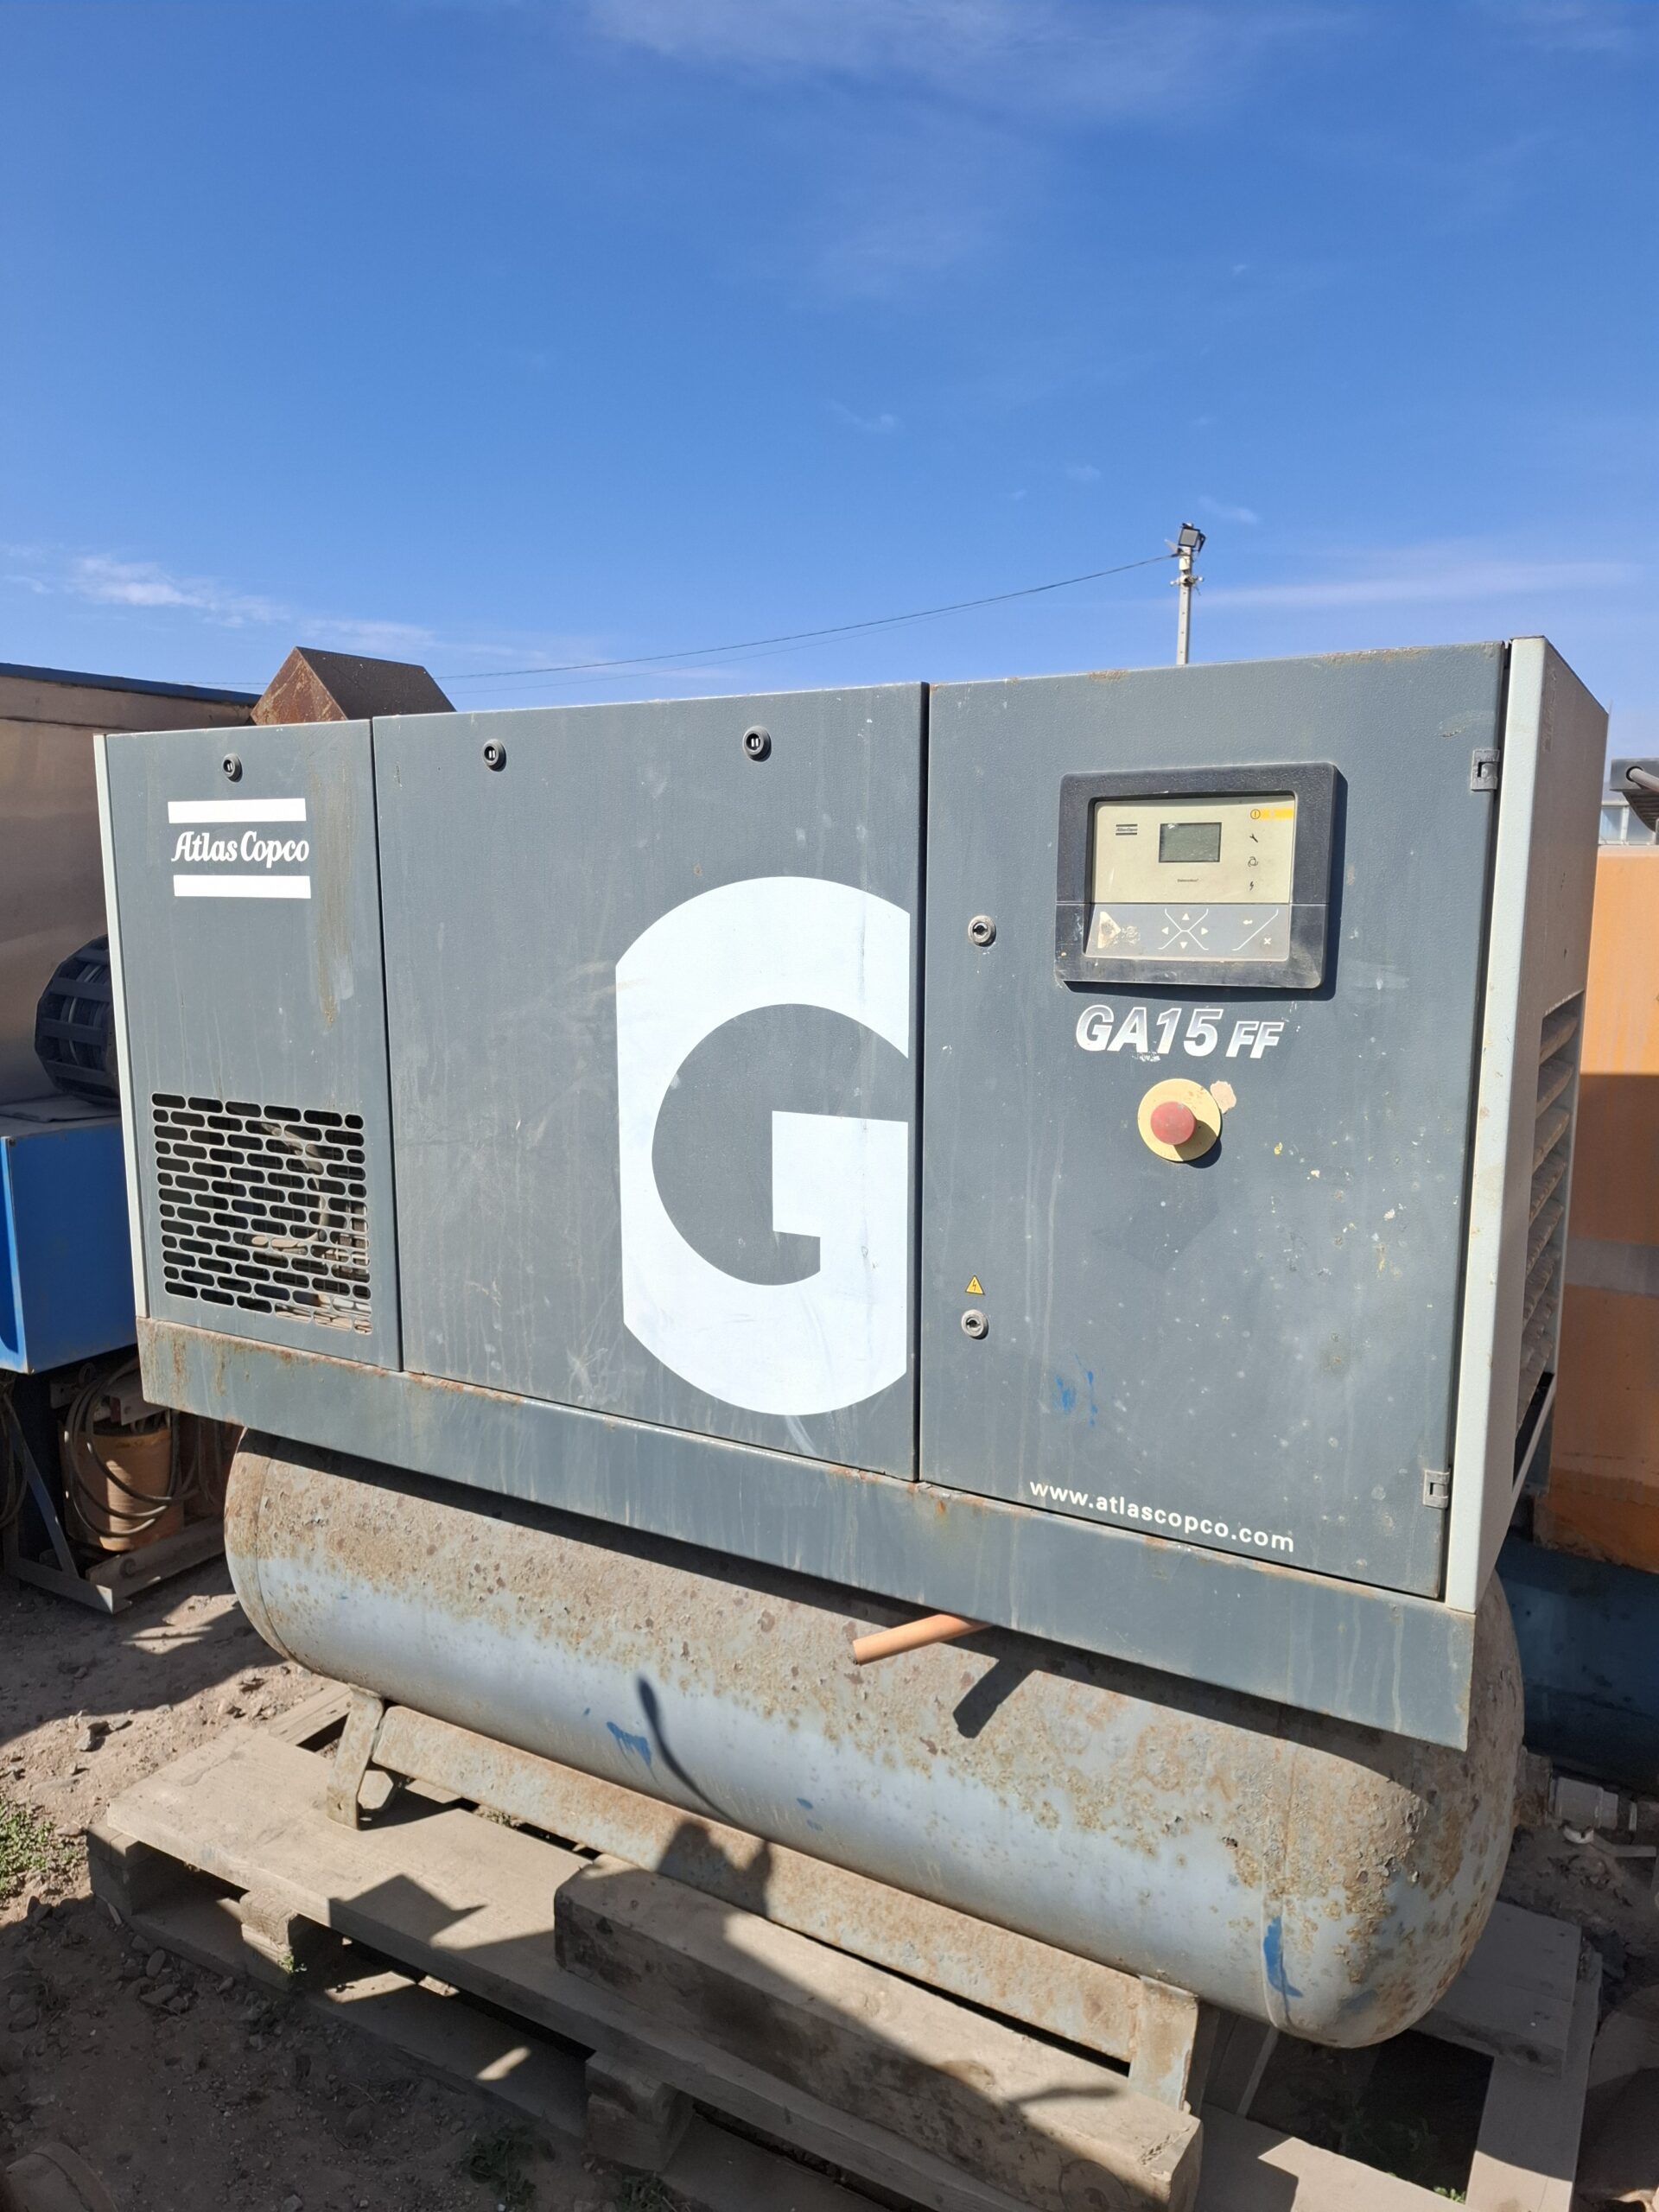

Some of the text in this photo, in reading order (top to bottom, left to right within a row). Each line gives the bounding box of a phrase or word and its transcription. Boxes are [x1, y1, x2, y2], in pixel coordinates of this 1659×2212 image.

[171, 830, 309, 868] Atlas Copco
[1076, 1004, 1285, 1058] GA15 FF
[615, 876, 910, 1415] G
[1029, 1481, 1294, 1552] www.atlascopco.com
